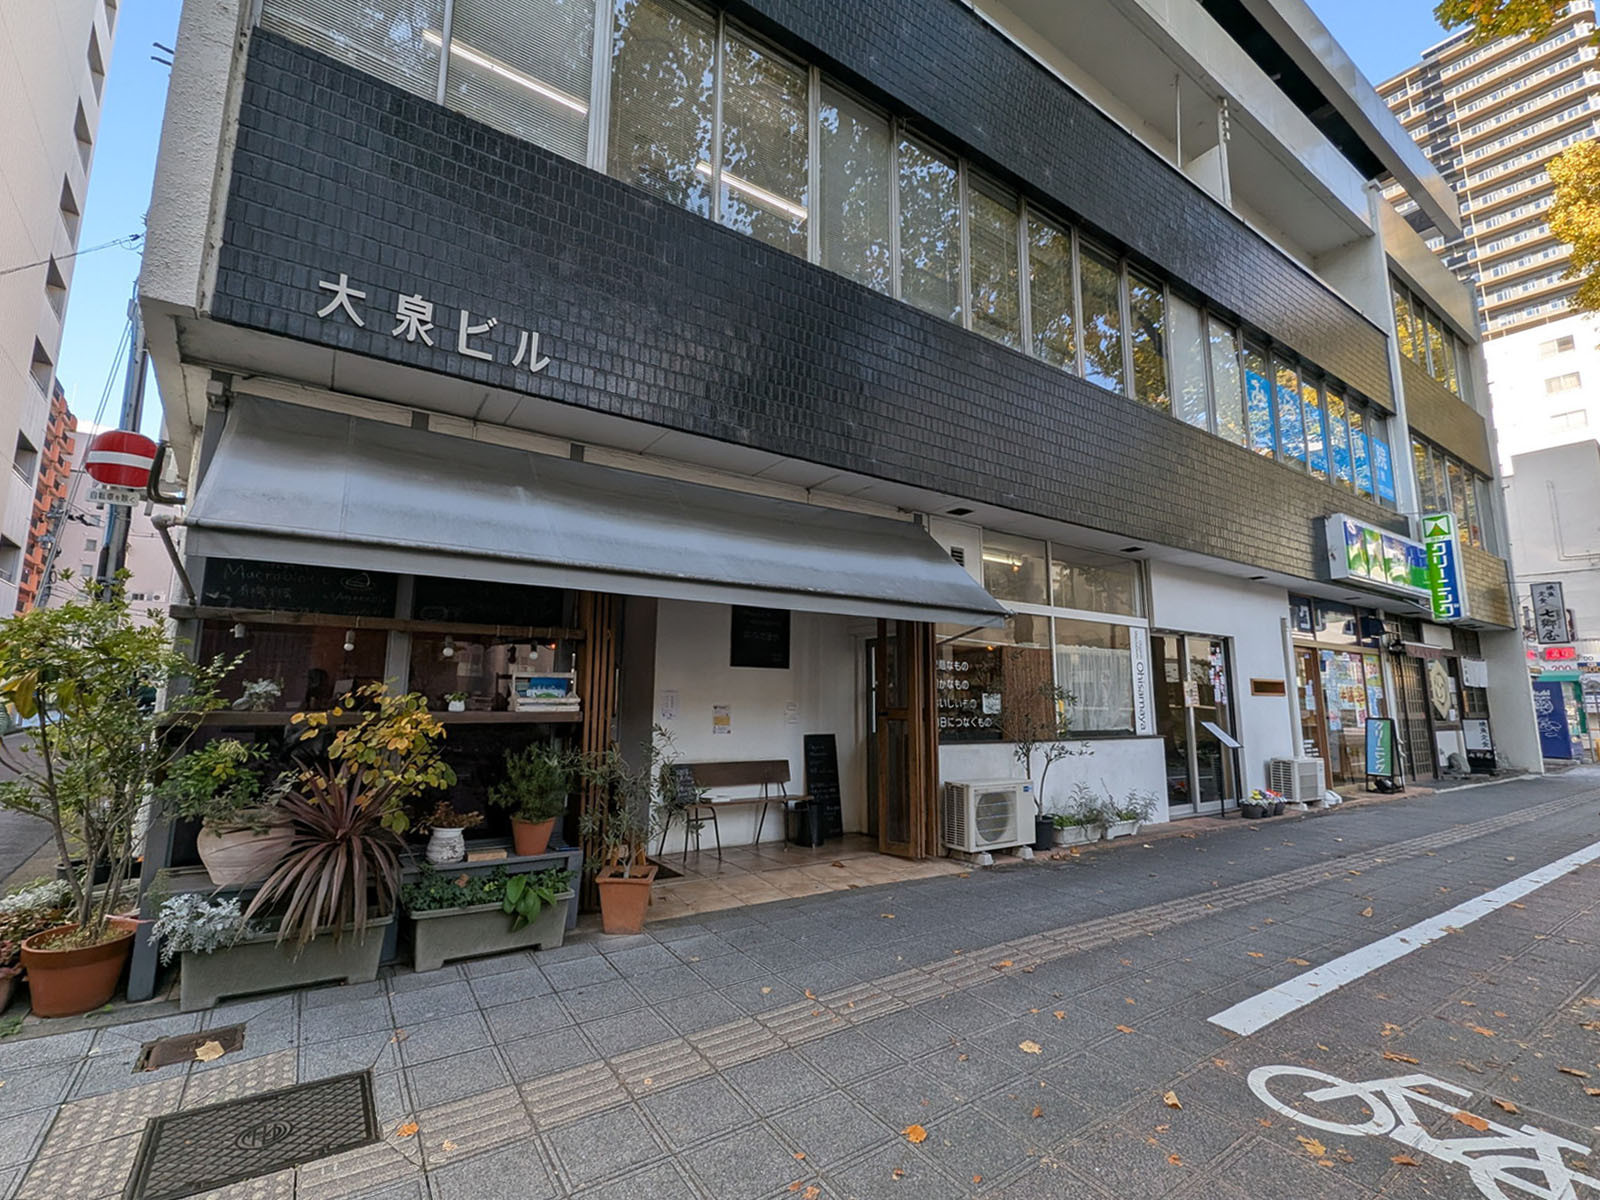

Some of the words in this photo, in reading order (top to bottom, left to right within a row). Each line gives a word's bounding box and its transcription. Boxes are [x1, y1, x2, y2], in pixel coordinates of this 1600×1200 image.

[317, 273, 551, 373] 大泉ビル
[89, 490, 136, 503] 自転車を除く
[1432, 542, 1459, 617] クリーニング
[936, 679, 970, 690] かなもの
[1136, 661, 1147, 731] Ohisamaya
[1374, 720, 1385, 773] クリーニング
